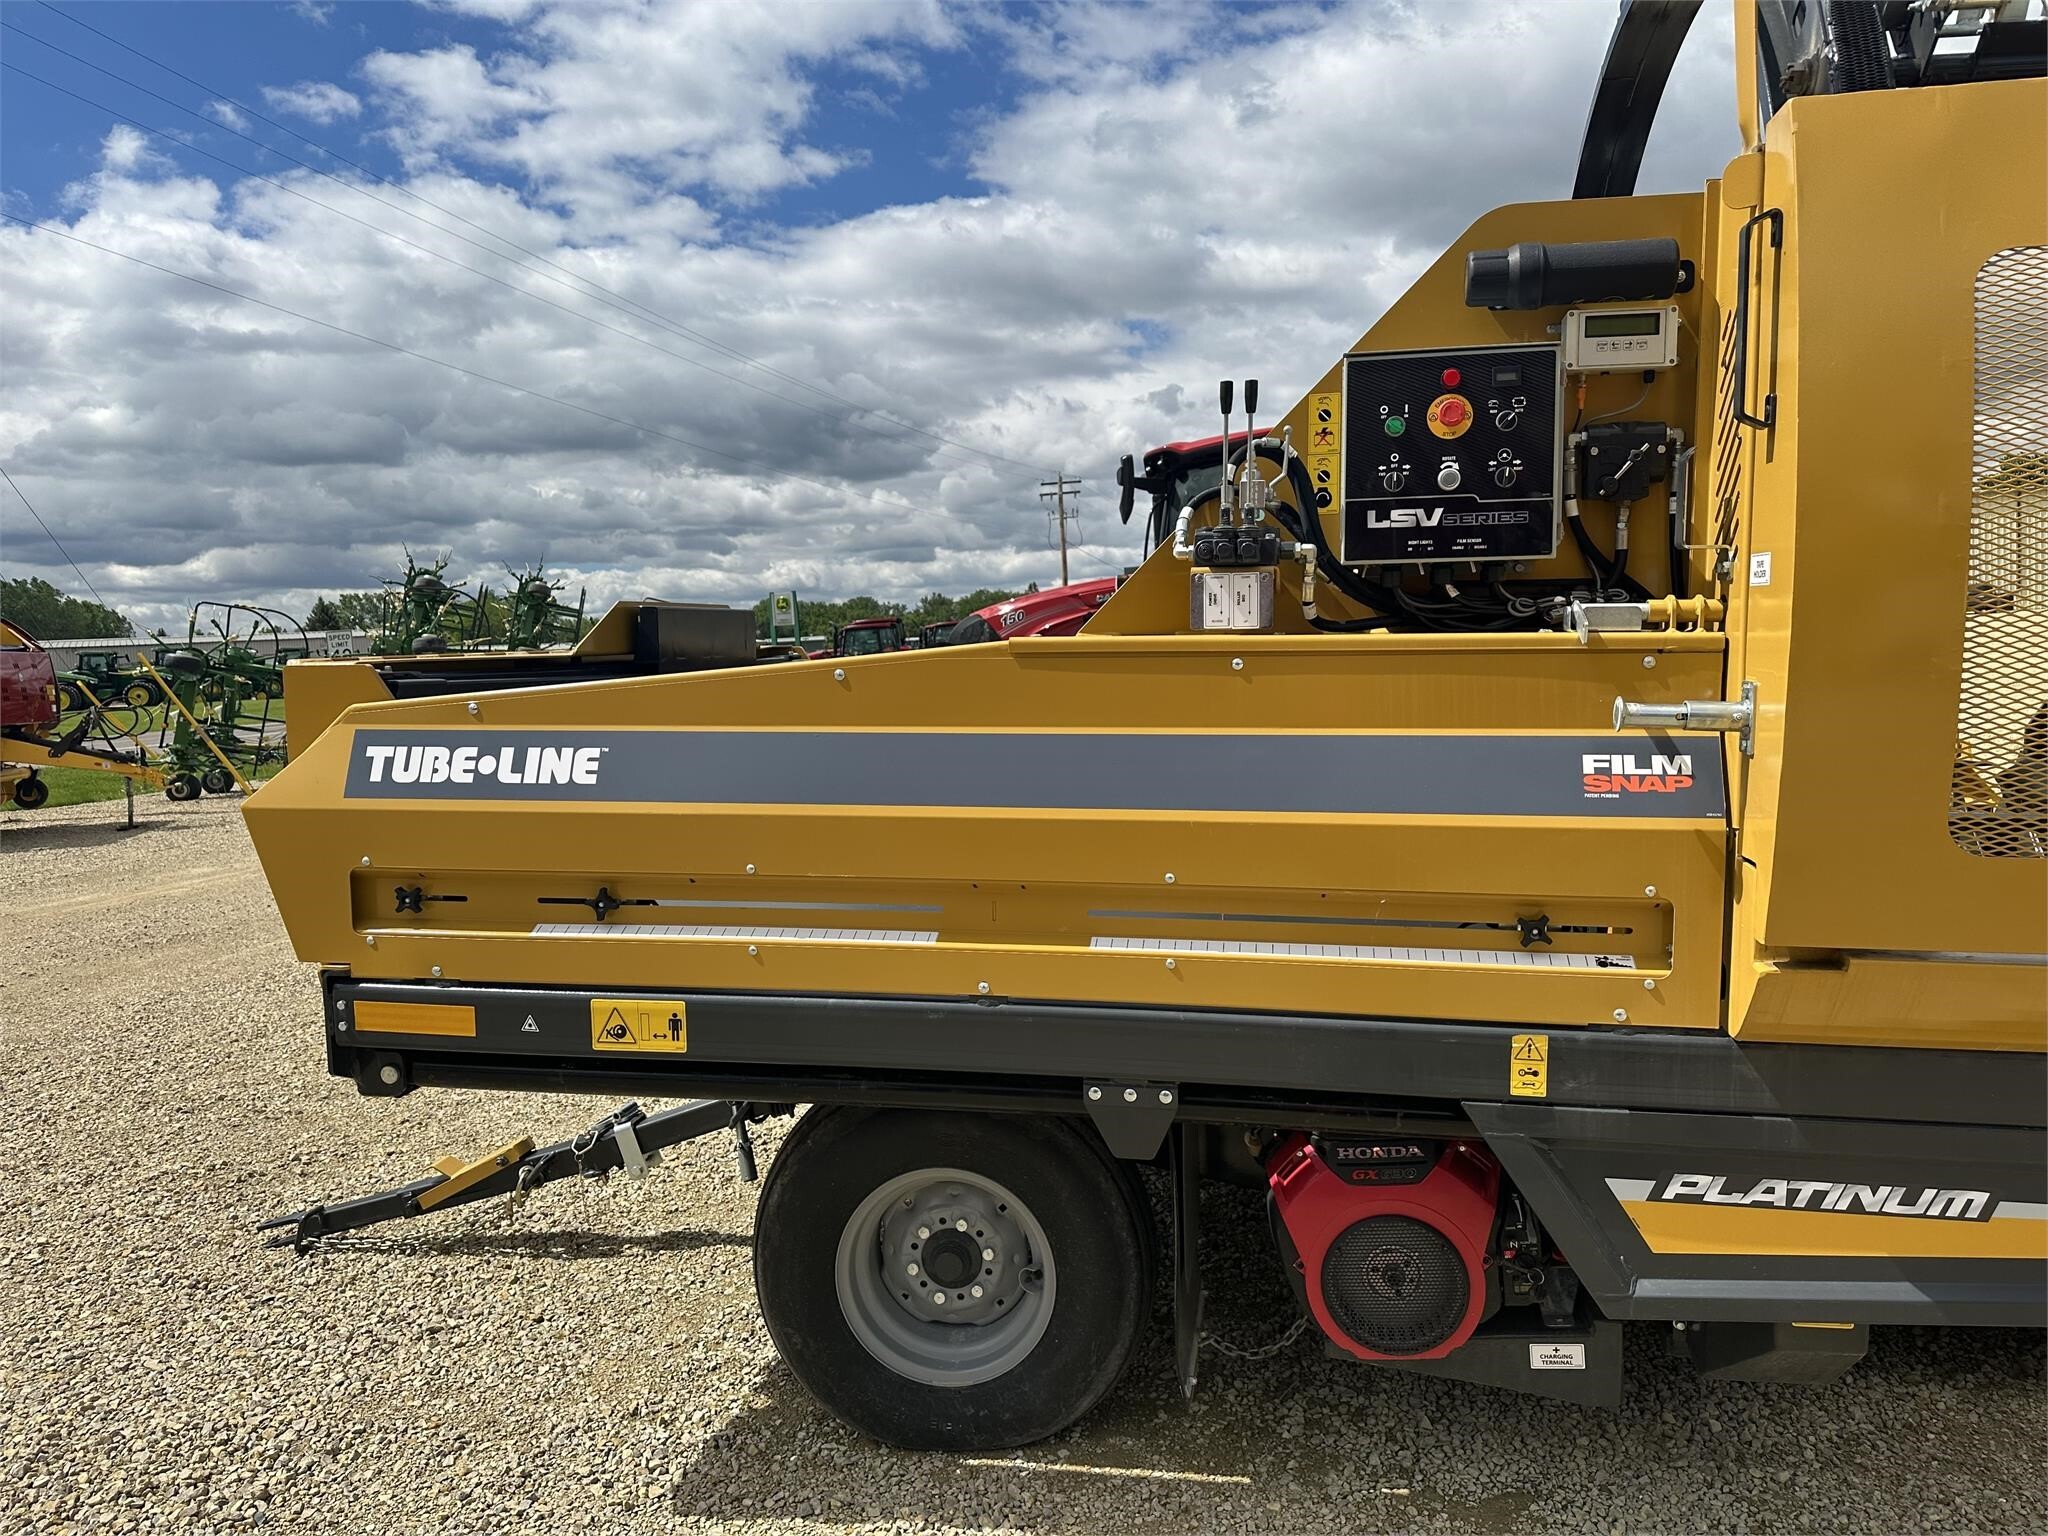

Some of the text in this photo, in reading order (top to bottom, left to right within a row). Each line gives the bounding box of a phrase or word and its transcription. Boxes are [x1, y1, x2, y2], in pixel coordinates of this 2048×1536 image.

[1367, 507, 1529, 529] LSV SERIES
[1000, 609, 1025, 627] 150
[1582, 754, 1693, 775] FILM
[1583, 775, 1693, 793] SNAP
[1336, 1145, 1425, 1159] HONDA
[1661, 1173, 1991, 1219] PLATINUM
